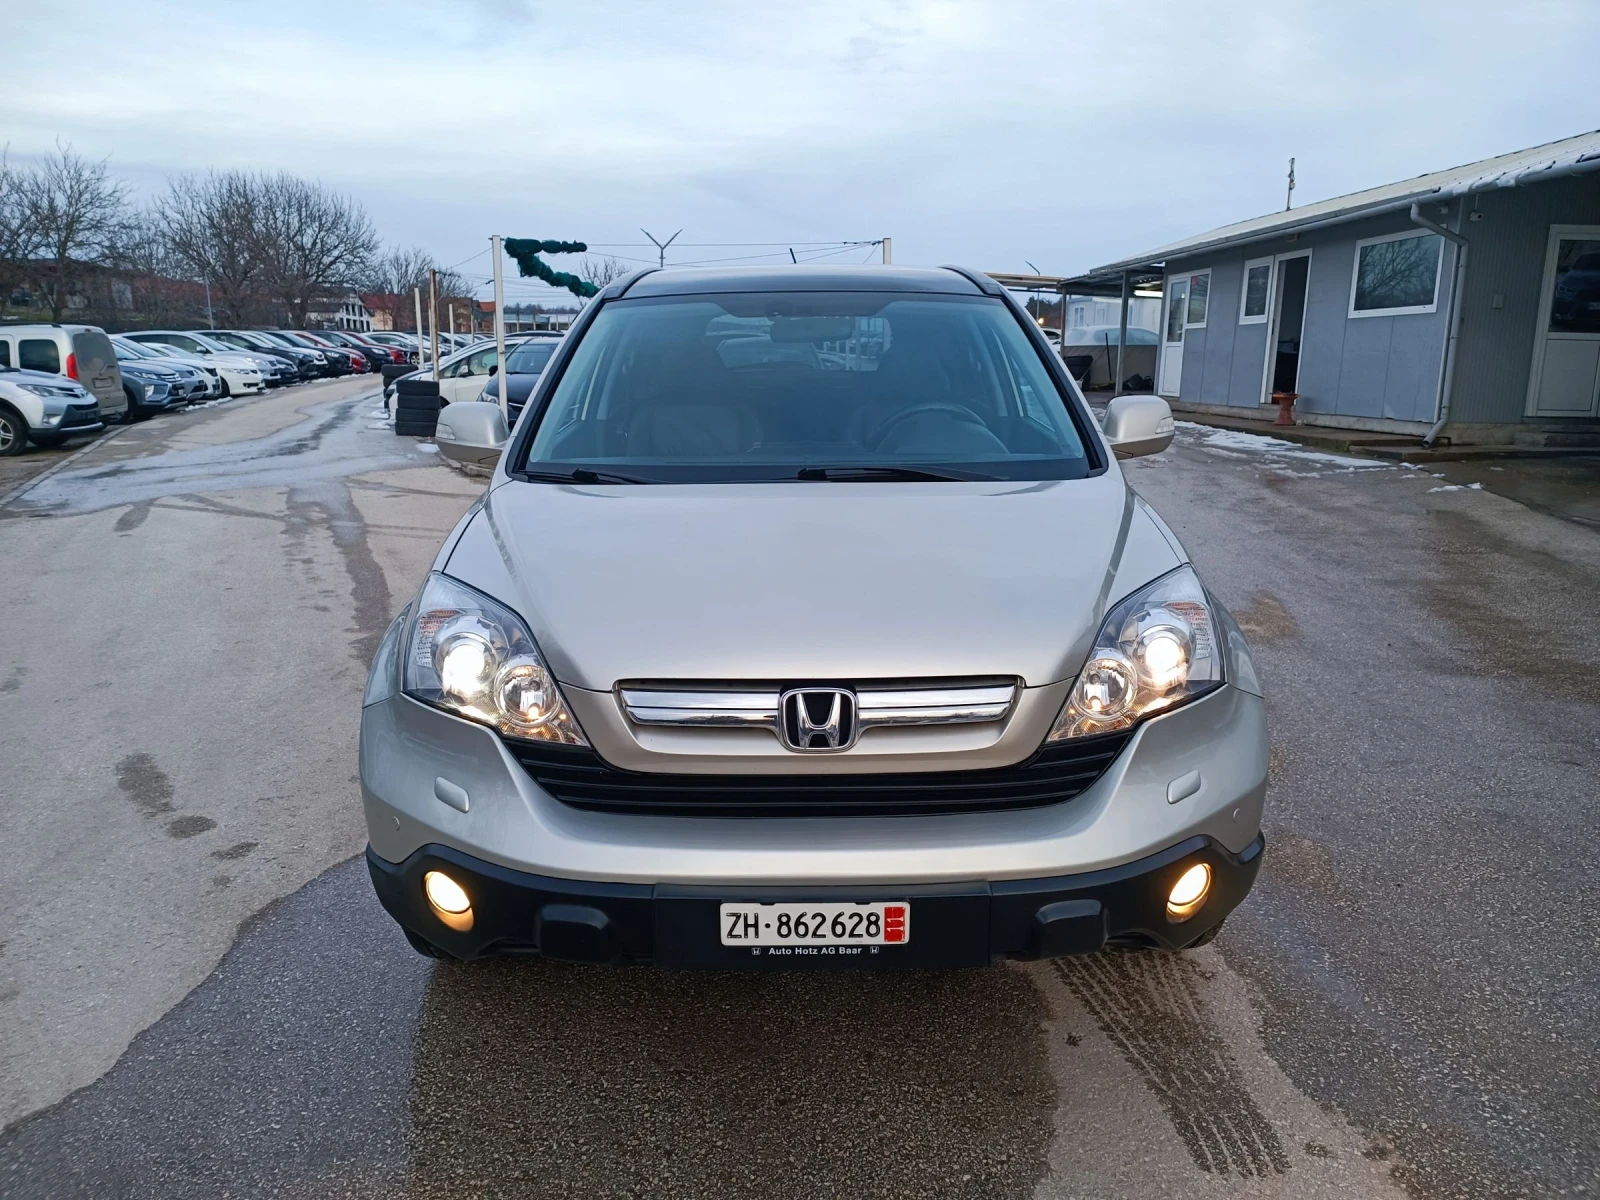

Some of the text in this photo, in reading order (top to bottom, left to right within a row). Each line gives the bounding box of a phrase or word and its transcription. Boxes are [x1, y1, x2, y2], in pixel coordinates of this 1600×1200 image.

[768, 947, 792, 955] Auto
[795, 947, 818, 955] Hotz
[821, 947, 836, 955] AG
